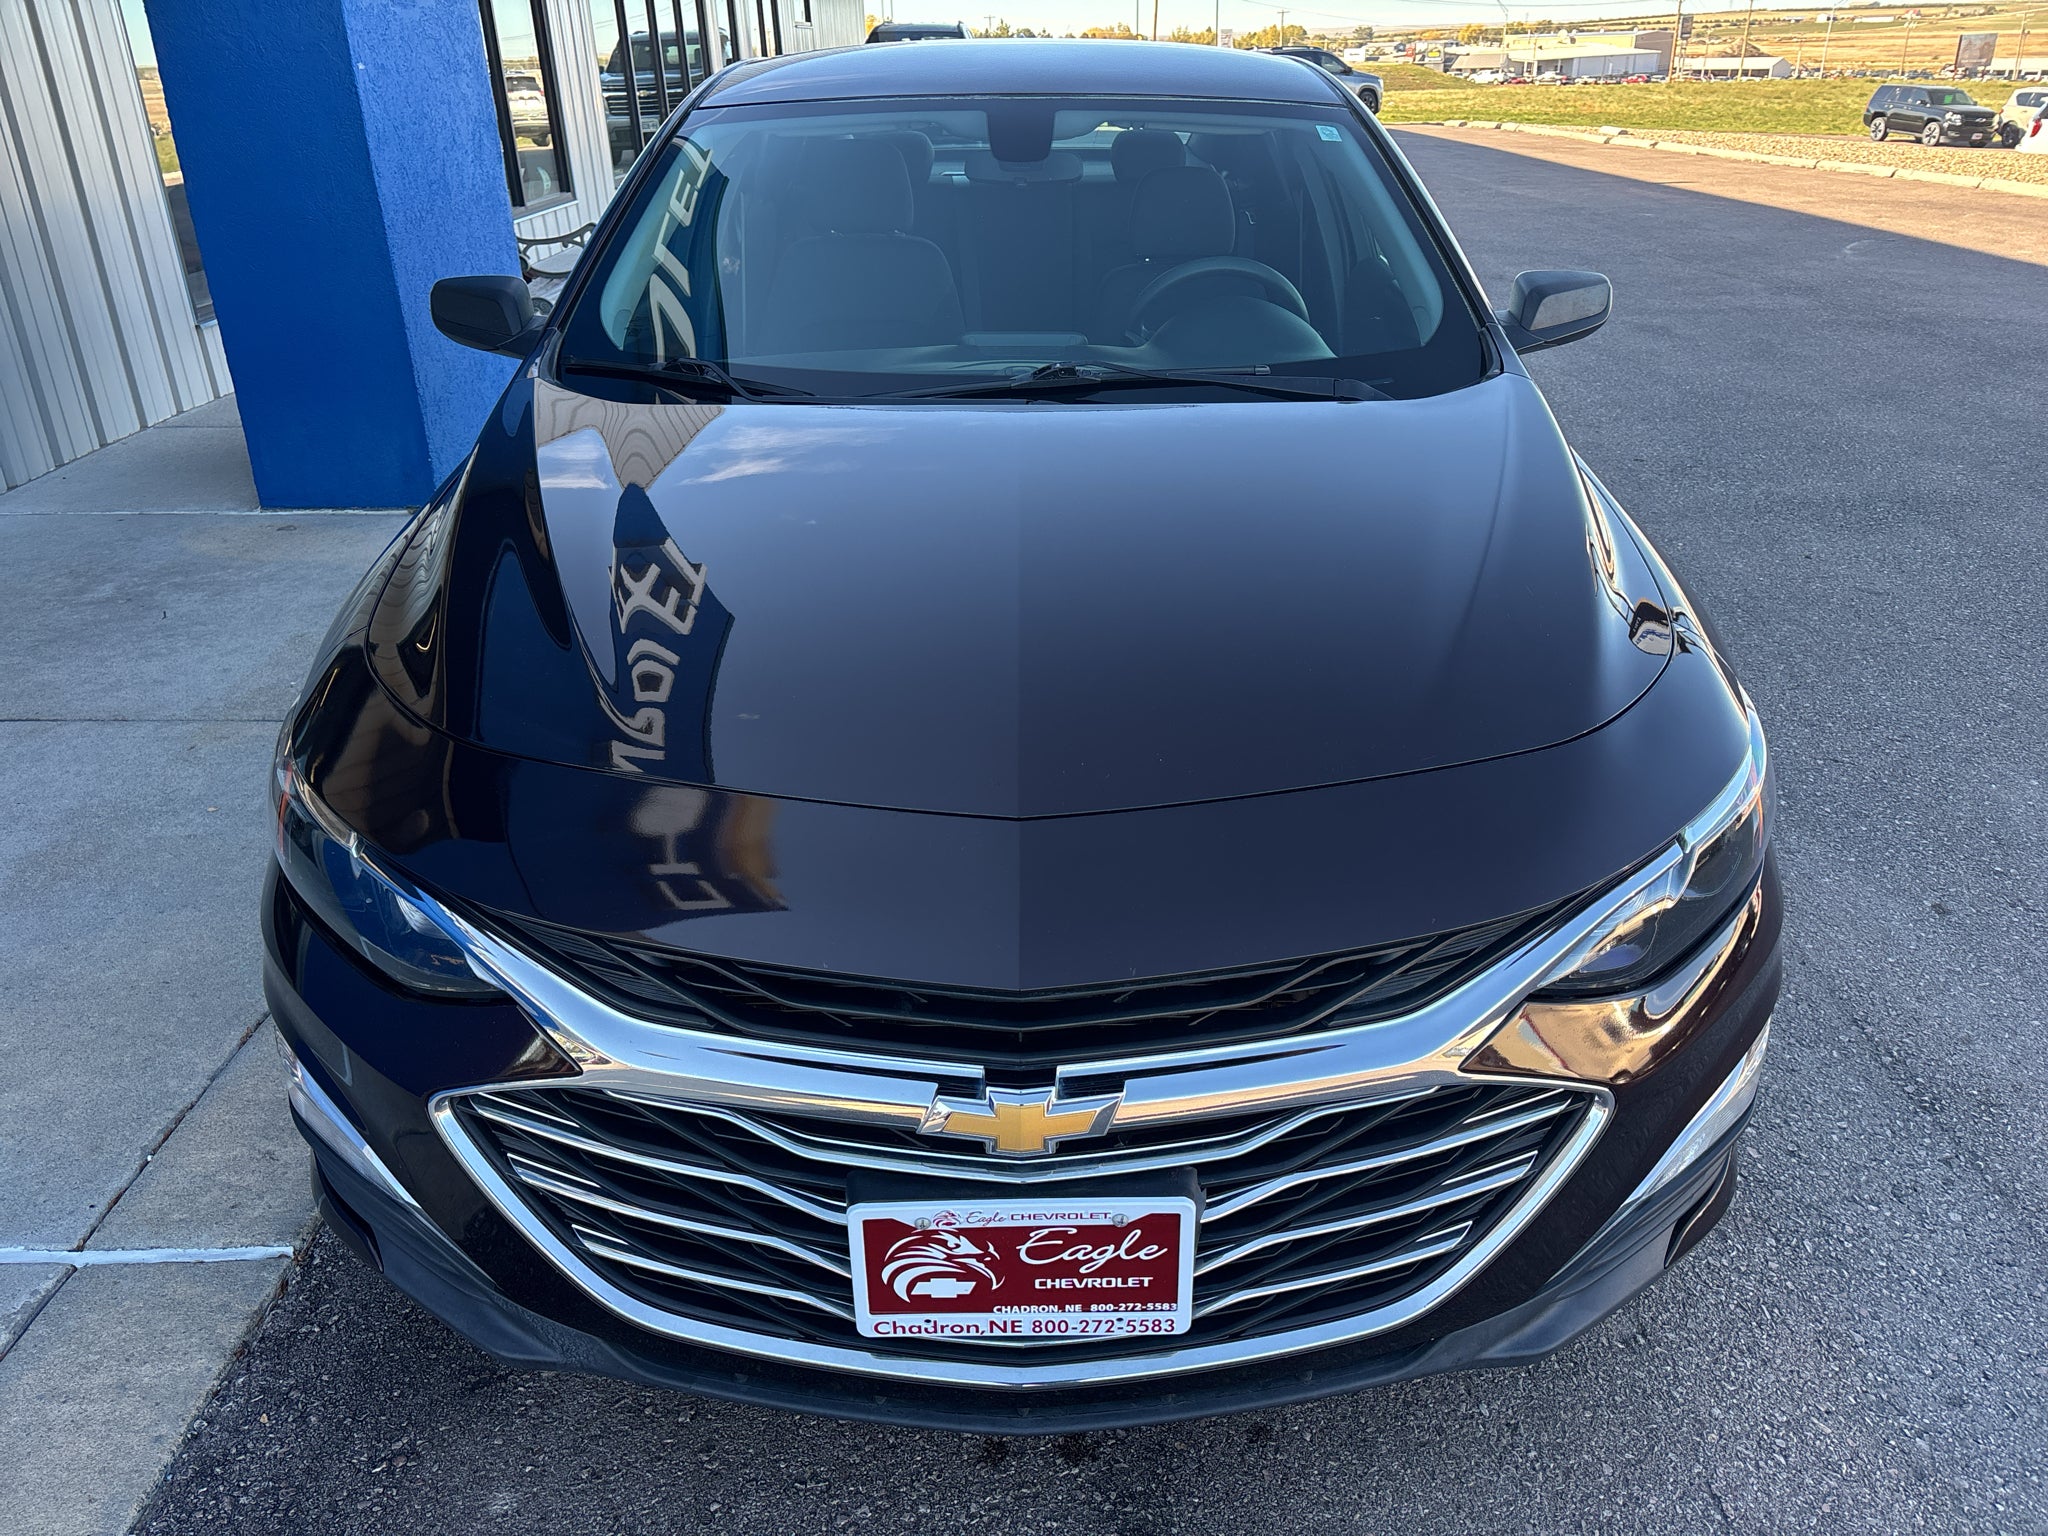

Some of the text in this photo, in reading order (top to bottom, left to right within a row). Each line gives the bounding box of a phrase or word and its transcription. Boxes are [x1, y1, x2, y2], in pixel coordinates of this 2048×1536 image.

[965, 1211, 1006, 1226] Eagle
[1015, 1227, 1168, 1273] Eagle
[1034, 1277, 1153, 1290] CHEVROLET
[993, 1303, 1178, 1314] CHADRON, NE 800-272-5583
[1031, 1318, 1175, 1334] 800-272-5583
